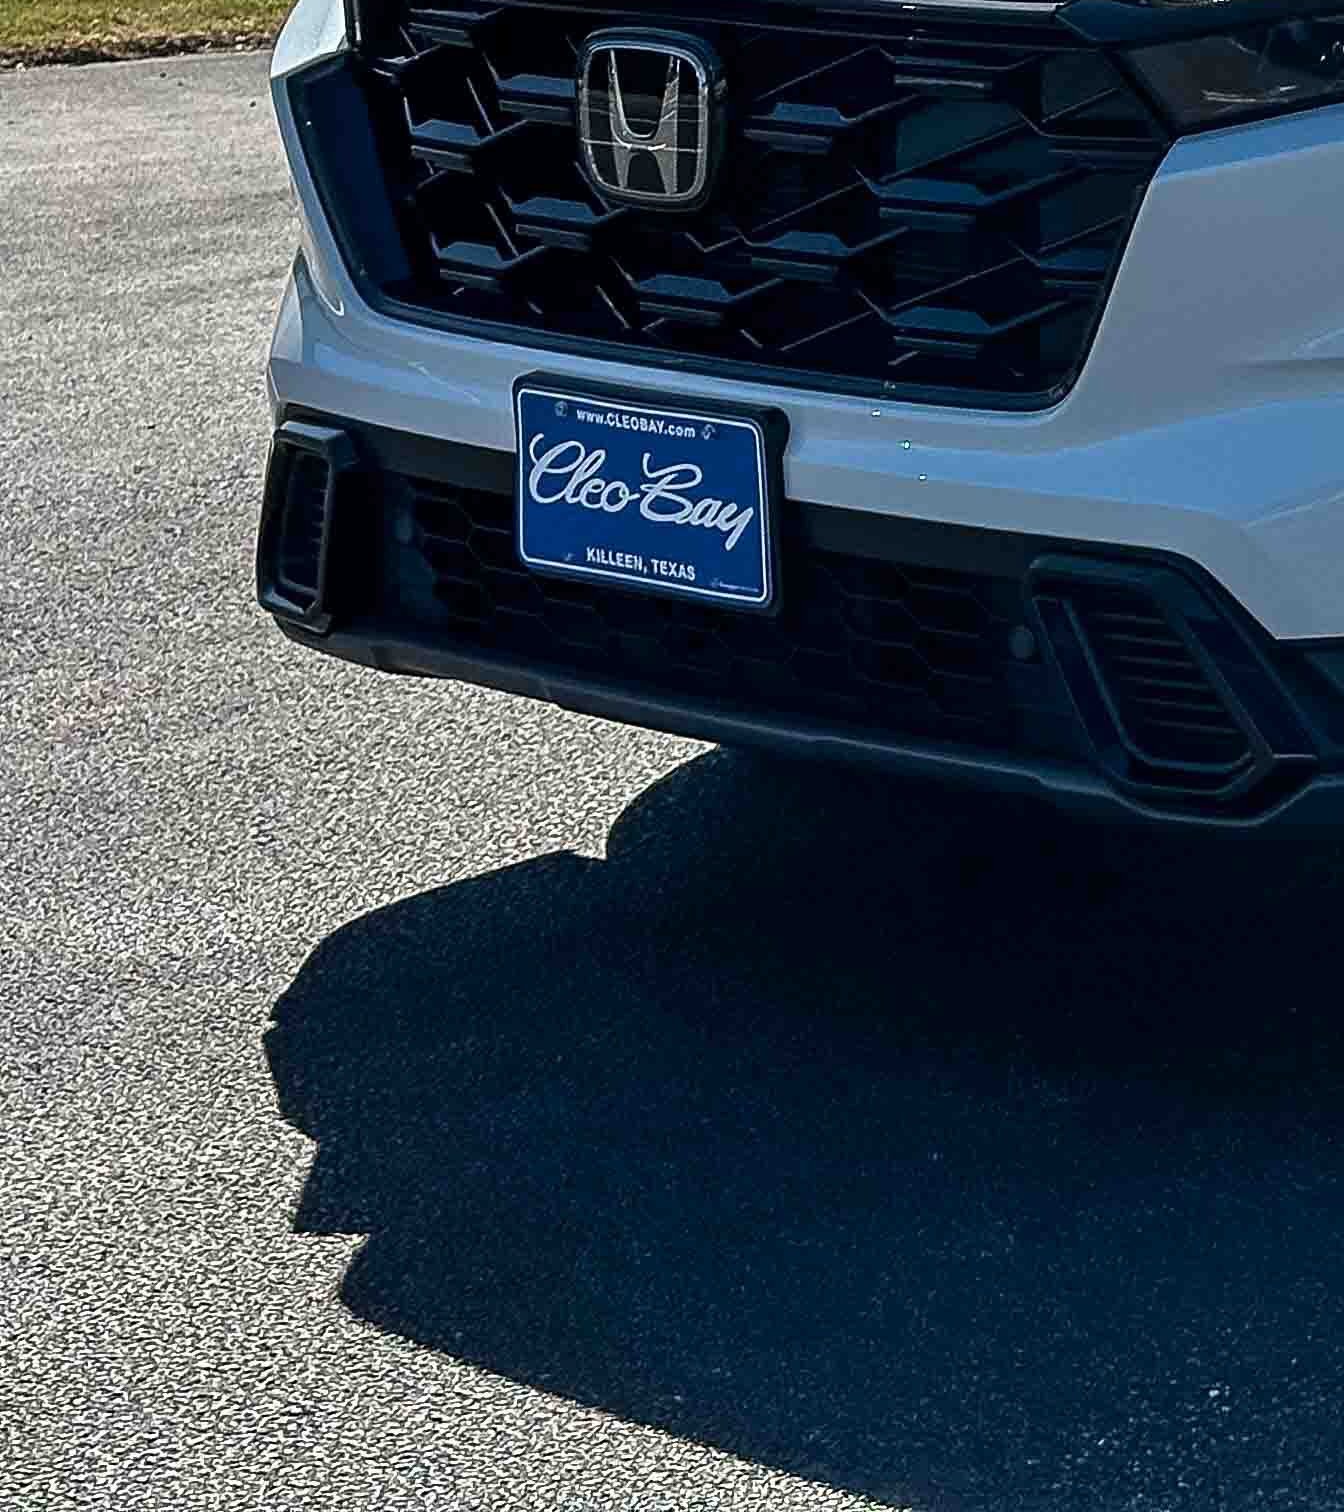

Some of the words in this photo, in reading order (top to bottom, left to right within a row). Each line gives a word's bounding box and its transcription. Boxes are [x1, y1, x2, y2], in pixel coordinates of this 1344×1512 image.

[576, 408, 696, 438] www.CLEOBAY.com
[528, 432, 640, 513] Cleo
[639, 452, 755, 552] Bay
[585, 546, 649, 574] KILLEEN,
[650, 558, 697, 581] TEXAS
